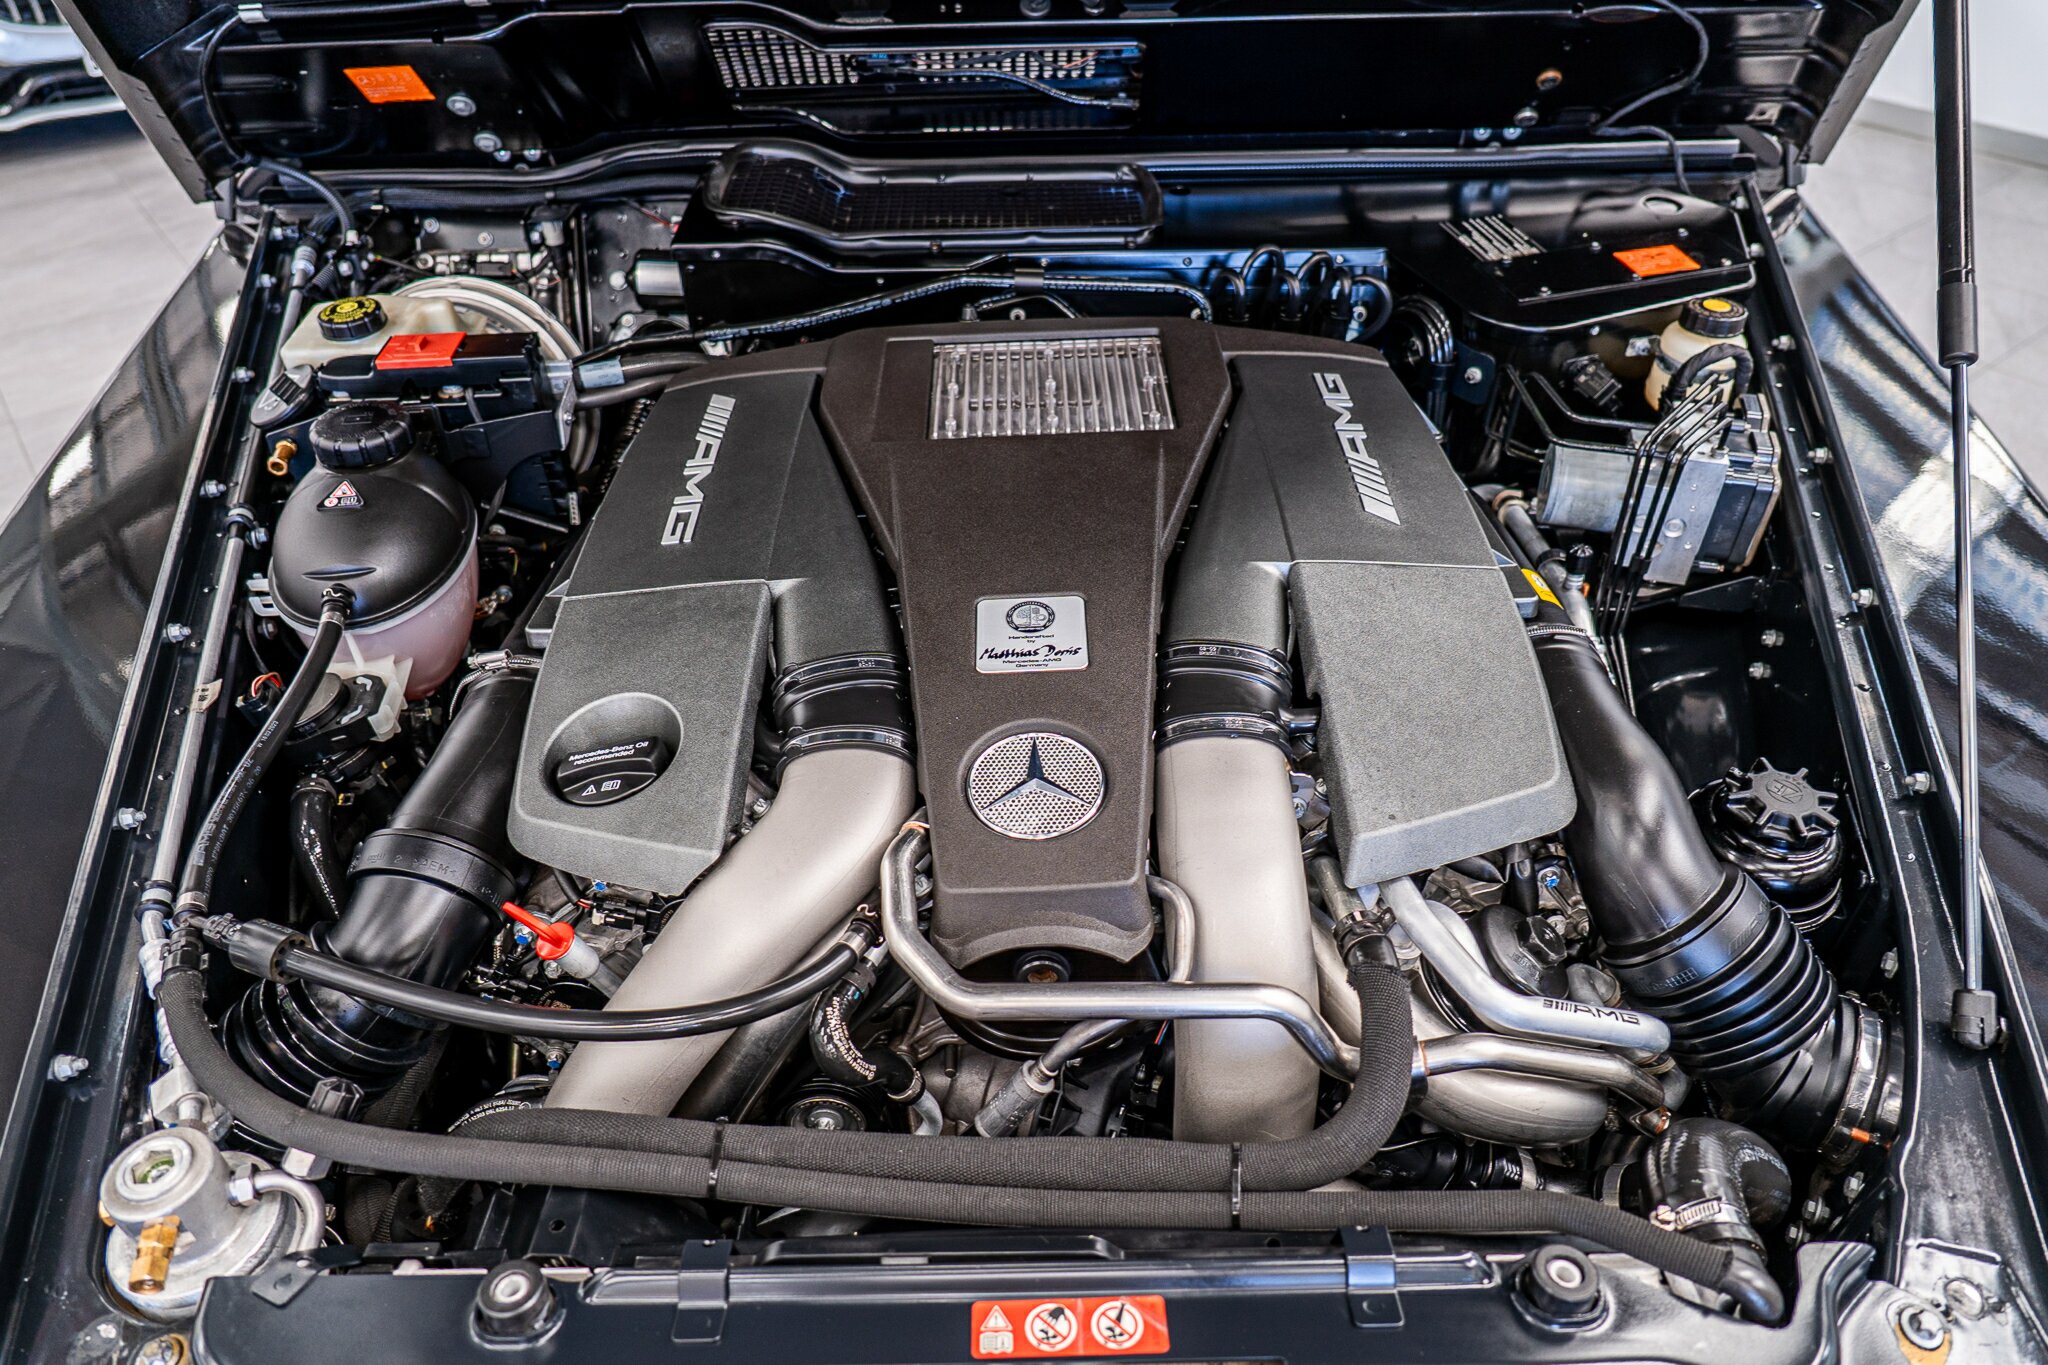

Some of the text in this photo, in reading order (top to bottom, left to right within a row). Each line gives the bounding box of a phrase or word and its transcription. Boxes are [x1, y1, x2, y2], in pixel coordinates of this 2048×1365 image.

[1312, 372, 1384, 482] AMG
[660, 424, 724, 545] AMG
[568, 741, 650, 762] Mercedes-Benz Oil
[573, 748, 636, 766] recommended
